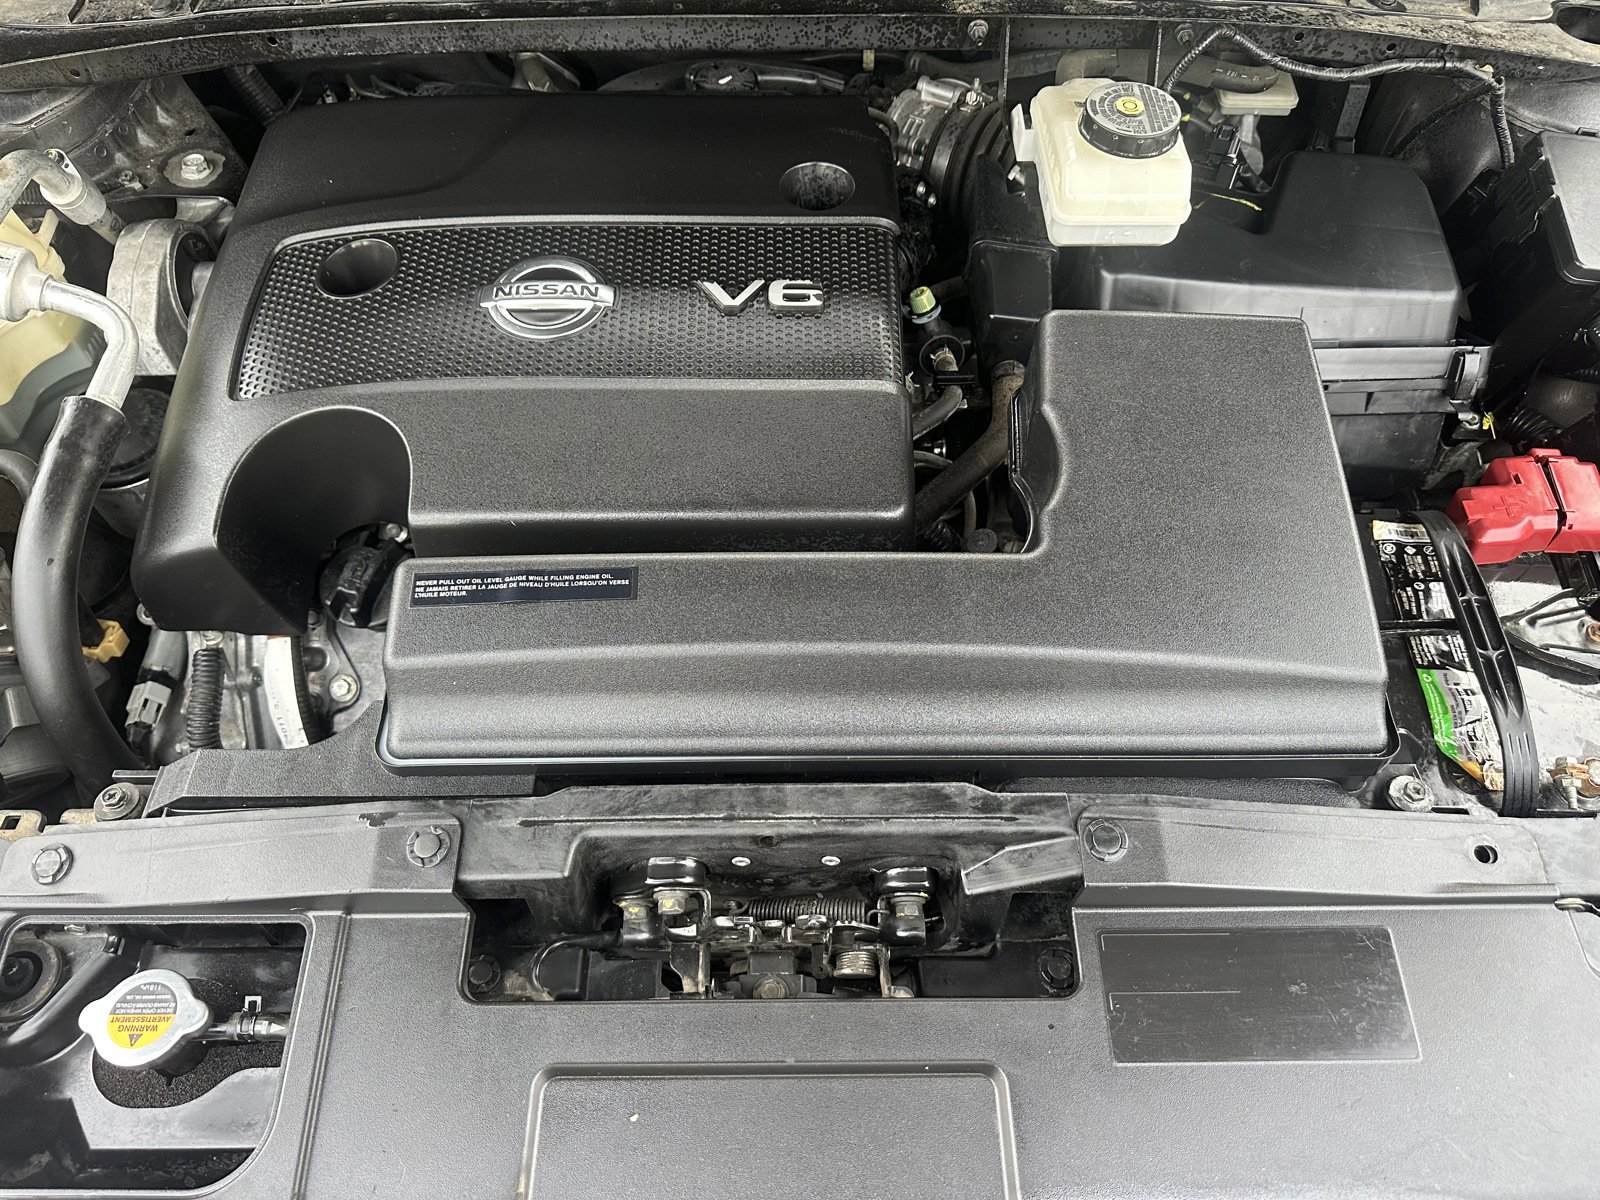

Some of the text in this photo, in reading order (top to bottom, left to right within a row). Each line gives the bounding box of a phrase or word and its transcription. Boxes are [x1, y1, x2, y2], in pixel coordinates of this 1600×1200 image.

[493, 282, 600, 299] NISSAN
[697, 278, 825, 317] V6
[117, 1024, 158, 1032] WARNING
